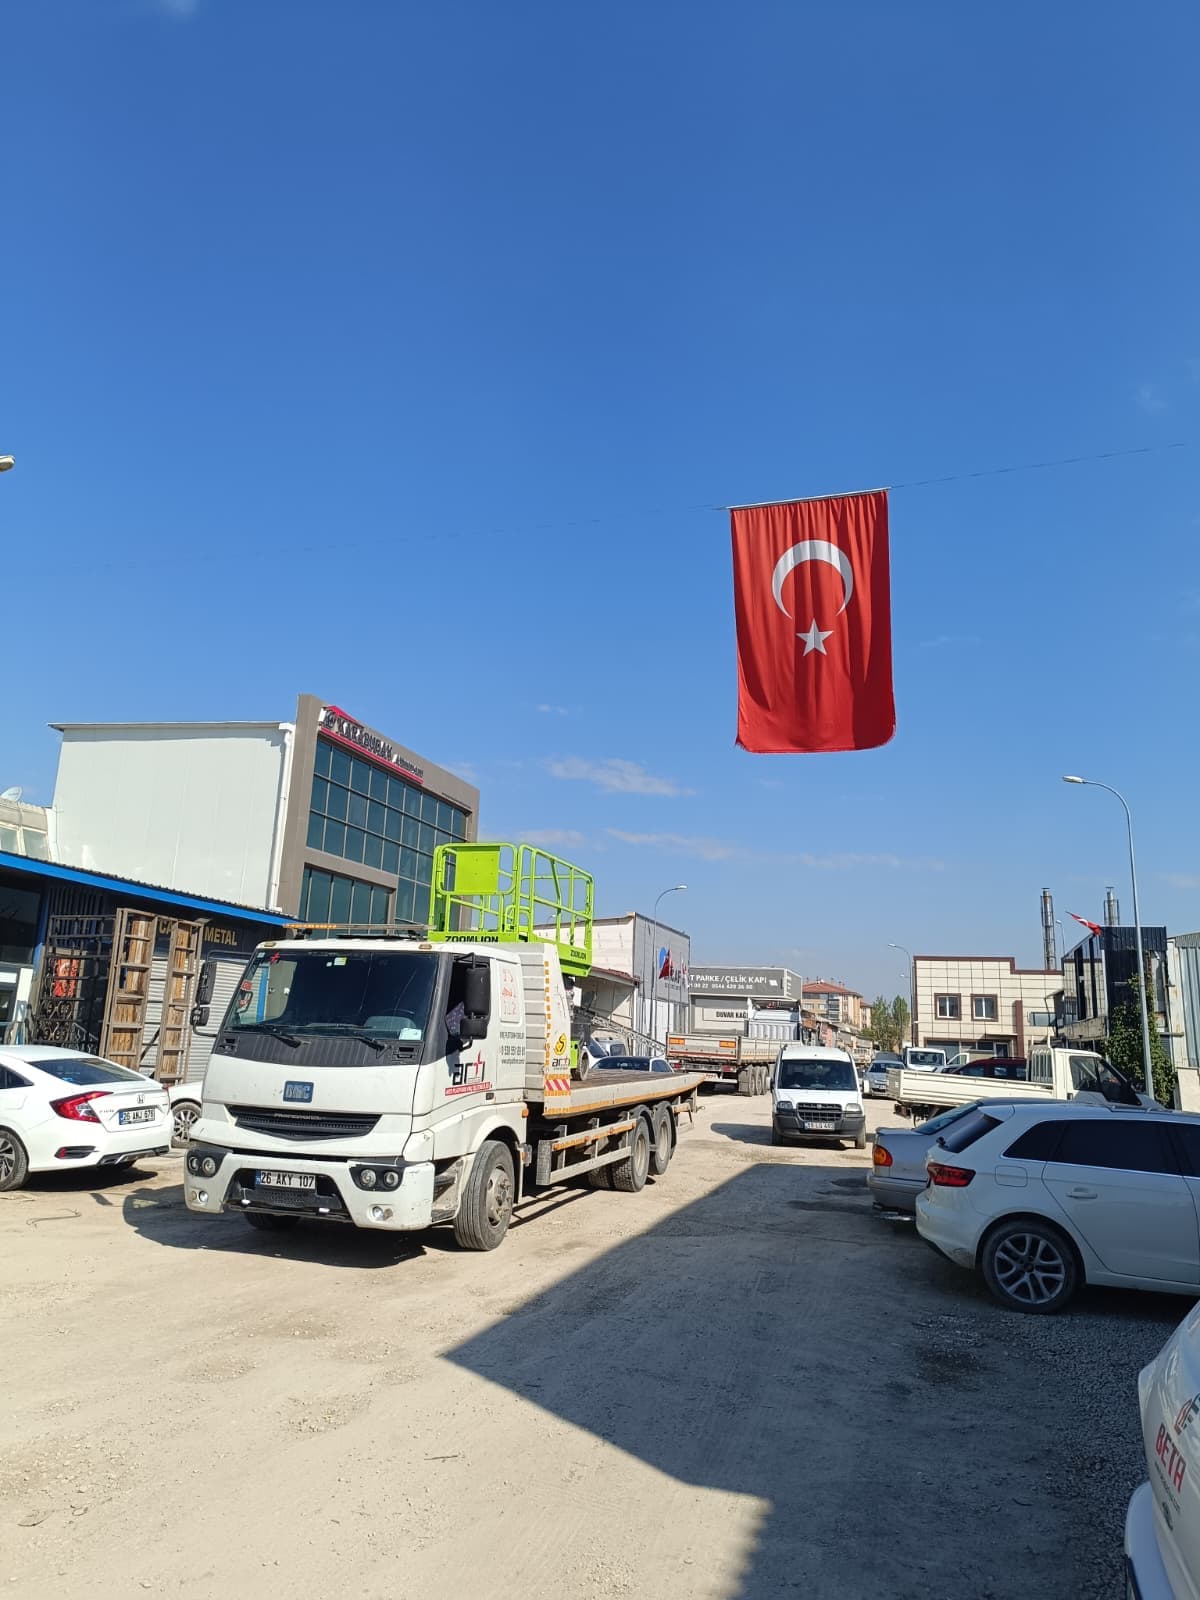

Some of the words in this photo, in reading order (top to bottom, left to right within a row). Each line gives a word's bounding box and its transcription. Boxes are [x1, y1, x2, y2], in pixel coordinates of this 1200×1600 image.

[204, 927, 237, 945] METAL
[445, 935, 499, 943] ZOOMLION
[716, 1011, 734, 1019] DUVAR
[261, 1172, 272, 1184] 26
[276, 1173, 293, 1186] AKY
[299, 1174, 315, 1187] 107
[1155, 1422, 1187, 1492] BETA
